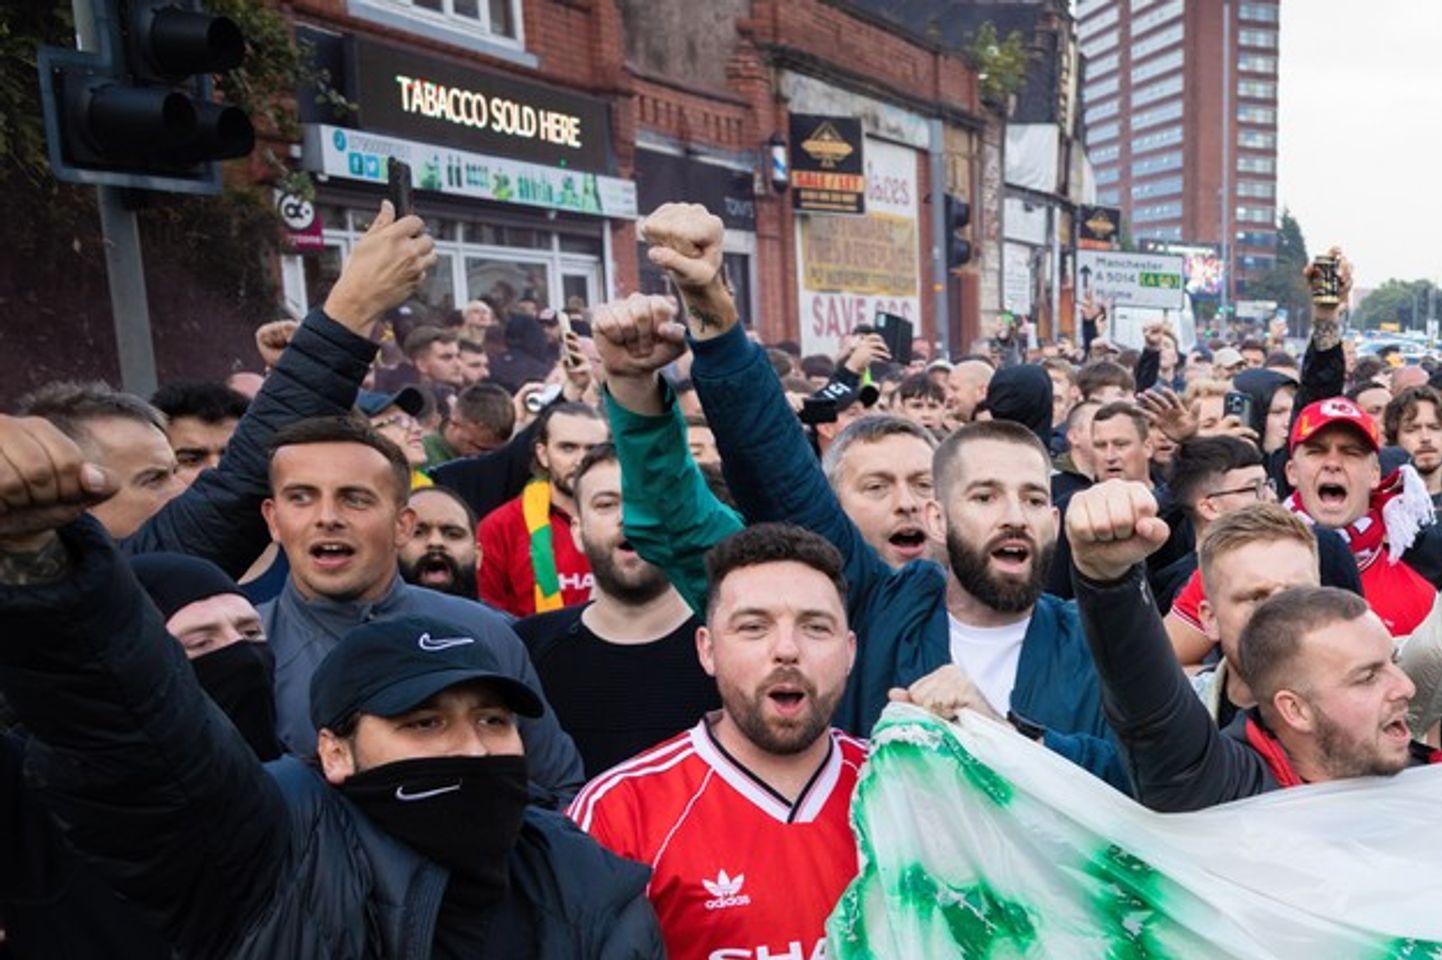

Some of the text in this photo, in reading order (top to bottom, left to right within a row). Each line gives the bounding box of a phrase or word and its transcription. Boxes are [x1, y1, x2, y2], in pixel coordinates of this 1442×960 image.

[395, 75, 582, 149] TABACCO SOLD HERE
[1095, 257, 1163, 270] Manchester
[705, 895, 751, 910] adidas
